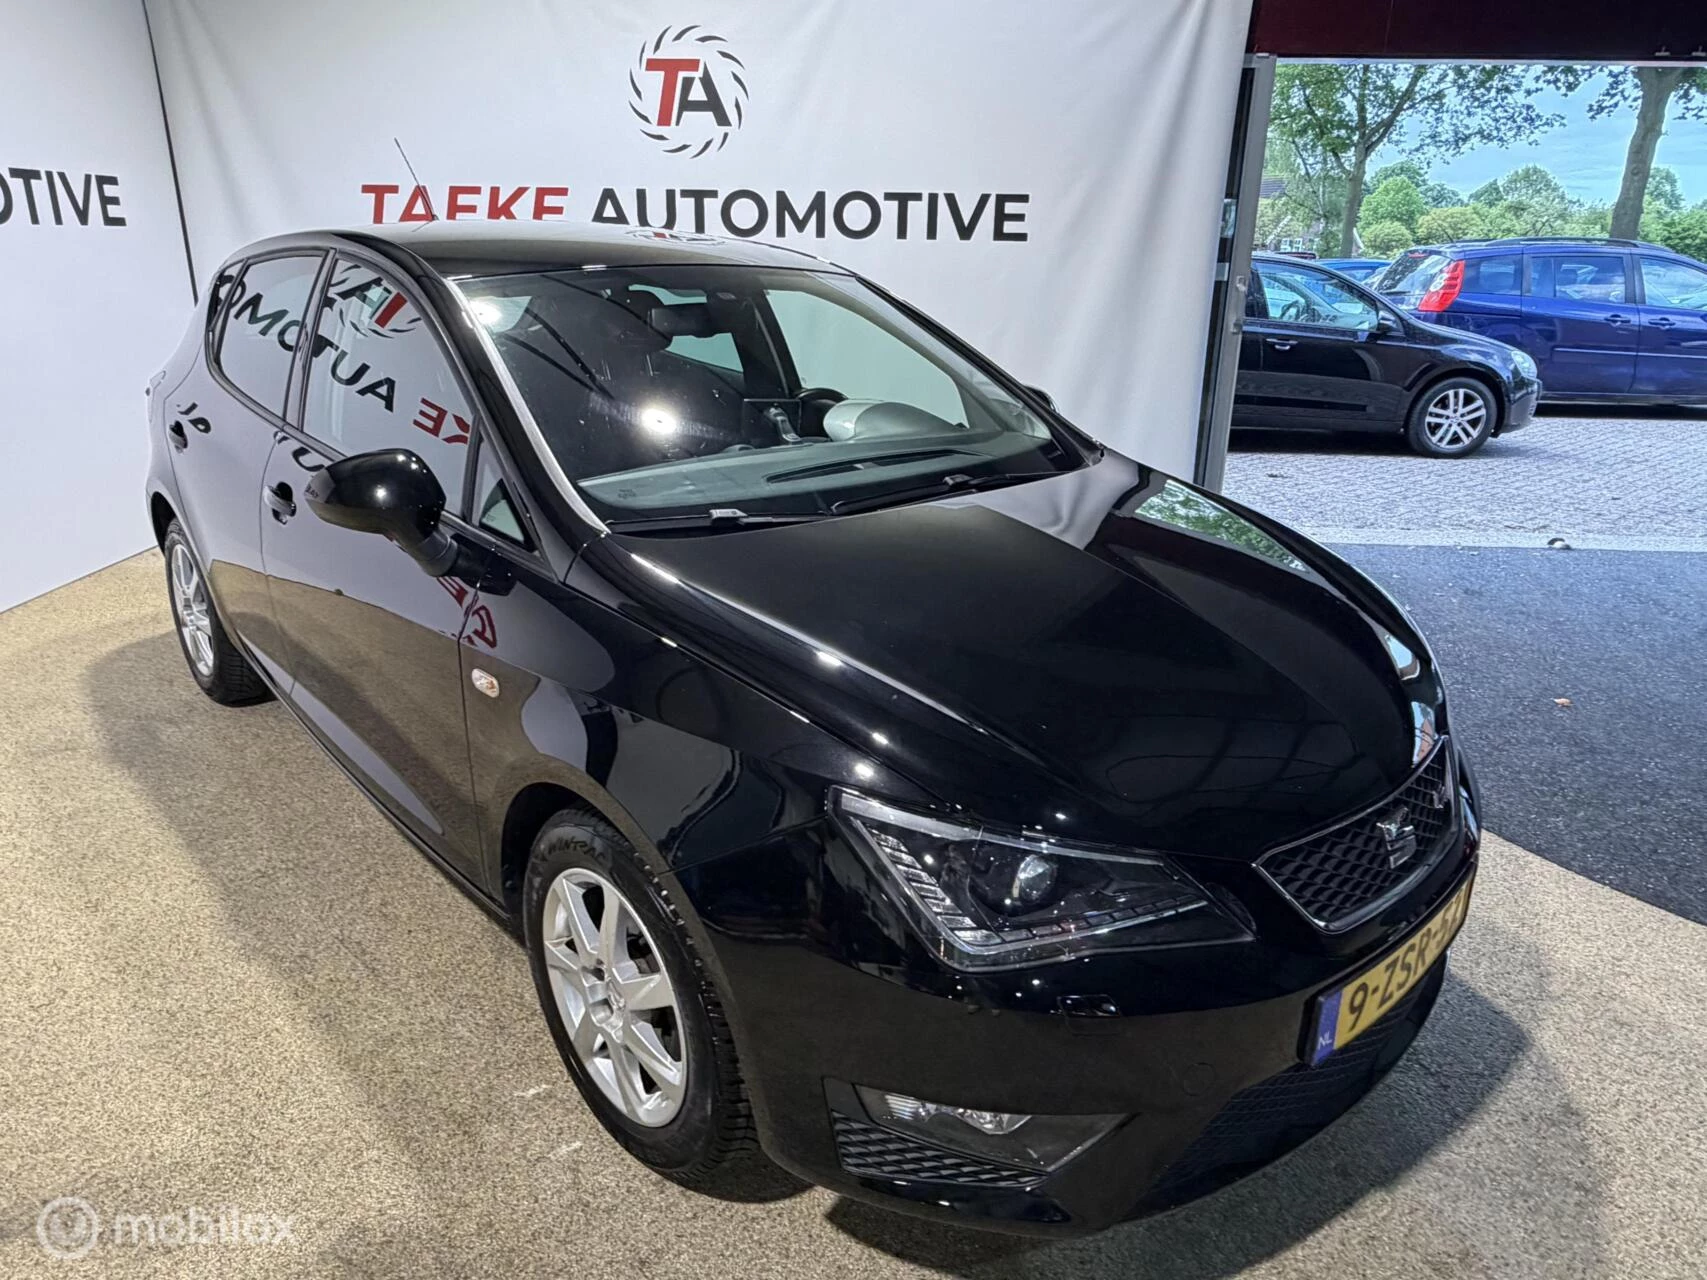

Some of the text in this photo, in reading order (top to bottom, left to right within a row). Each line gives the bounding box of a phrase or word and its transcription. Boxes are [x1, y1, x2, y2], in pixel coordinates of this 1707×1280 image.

[645, 58, 733, 127] TA
[591, 187, 1030, 242] AUTOMOTIVE
[1318, 1031, 1333, 1049] NL
